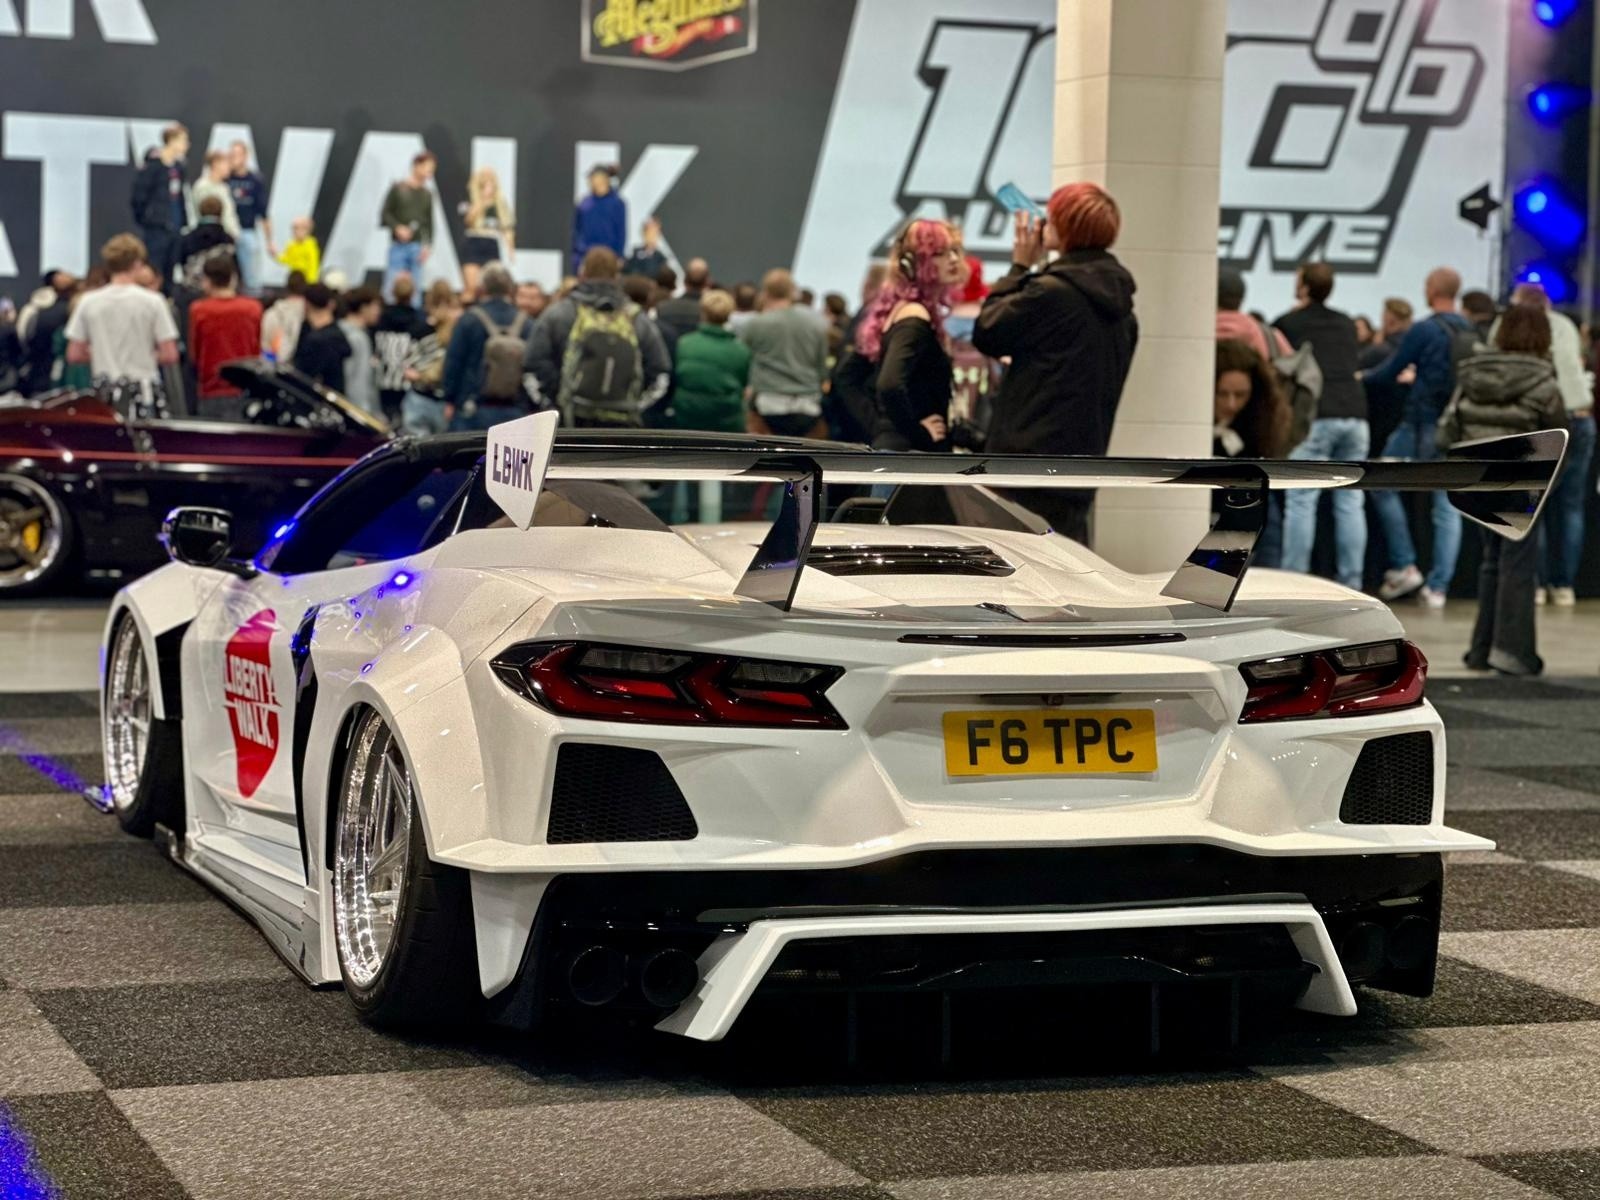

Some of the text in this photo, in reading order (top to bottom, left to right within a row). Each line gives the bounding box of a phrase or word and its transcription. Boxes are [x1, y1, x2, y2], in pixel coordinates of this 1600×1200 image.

[492, 443, 534, 492] LBWK
[224, 654, 278, 704] LIBERTY
[967, 718, 1135, 765] F6 TPC
